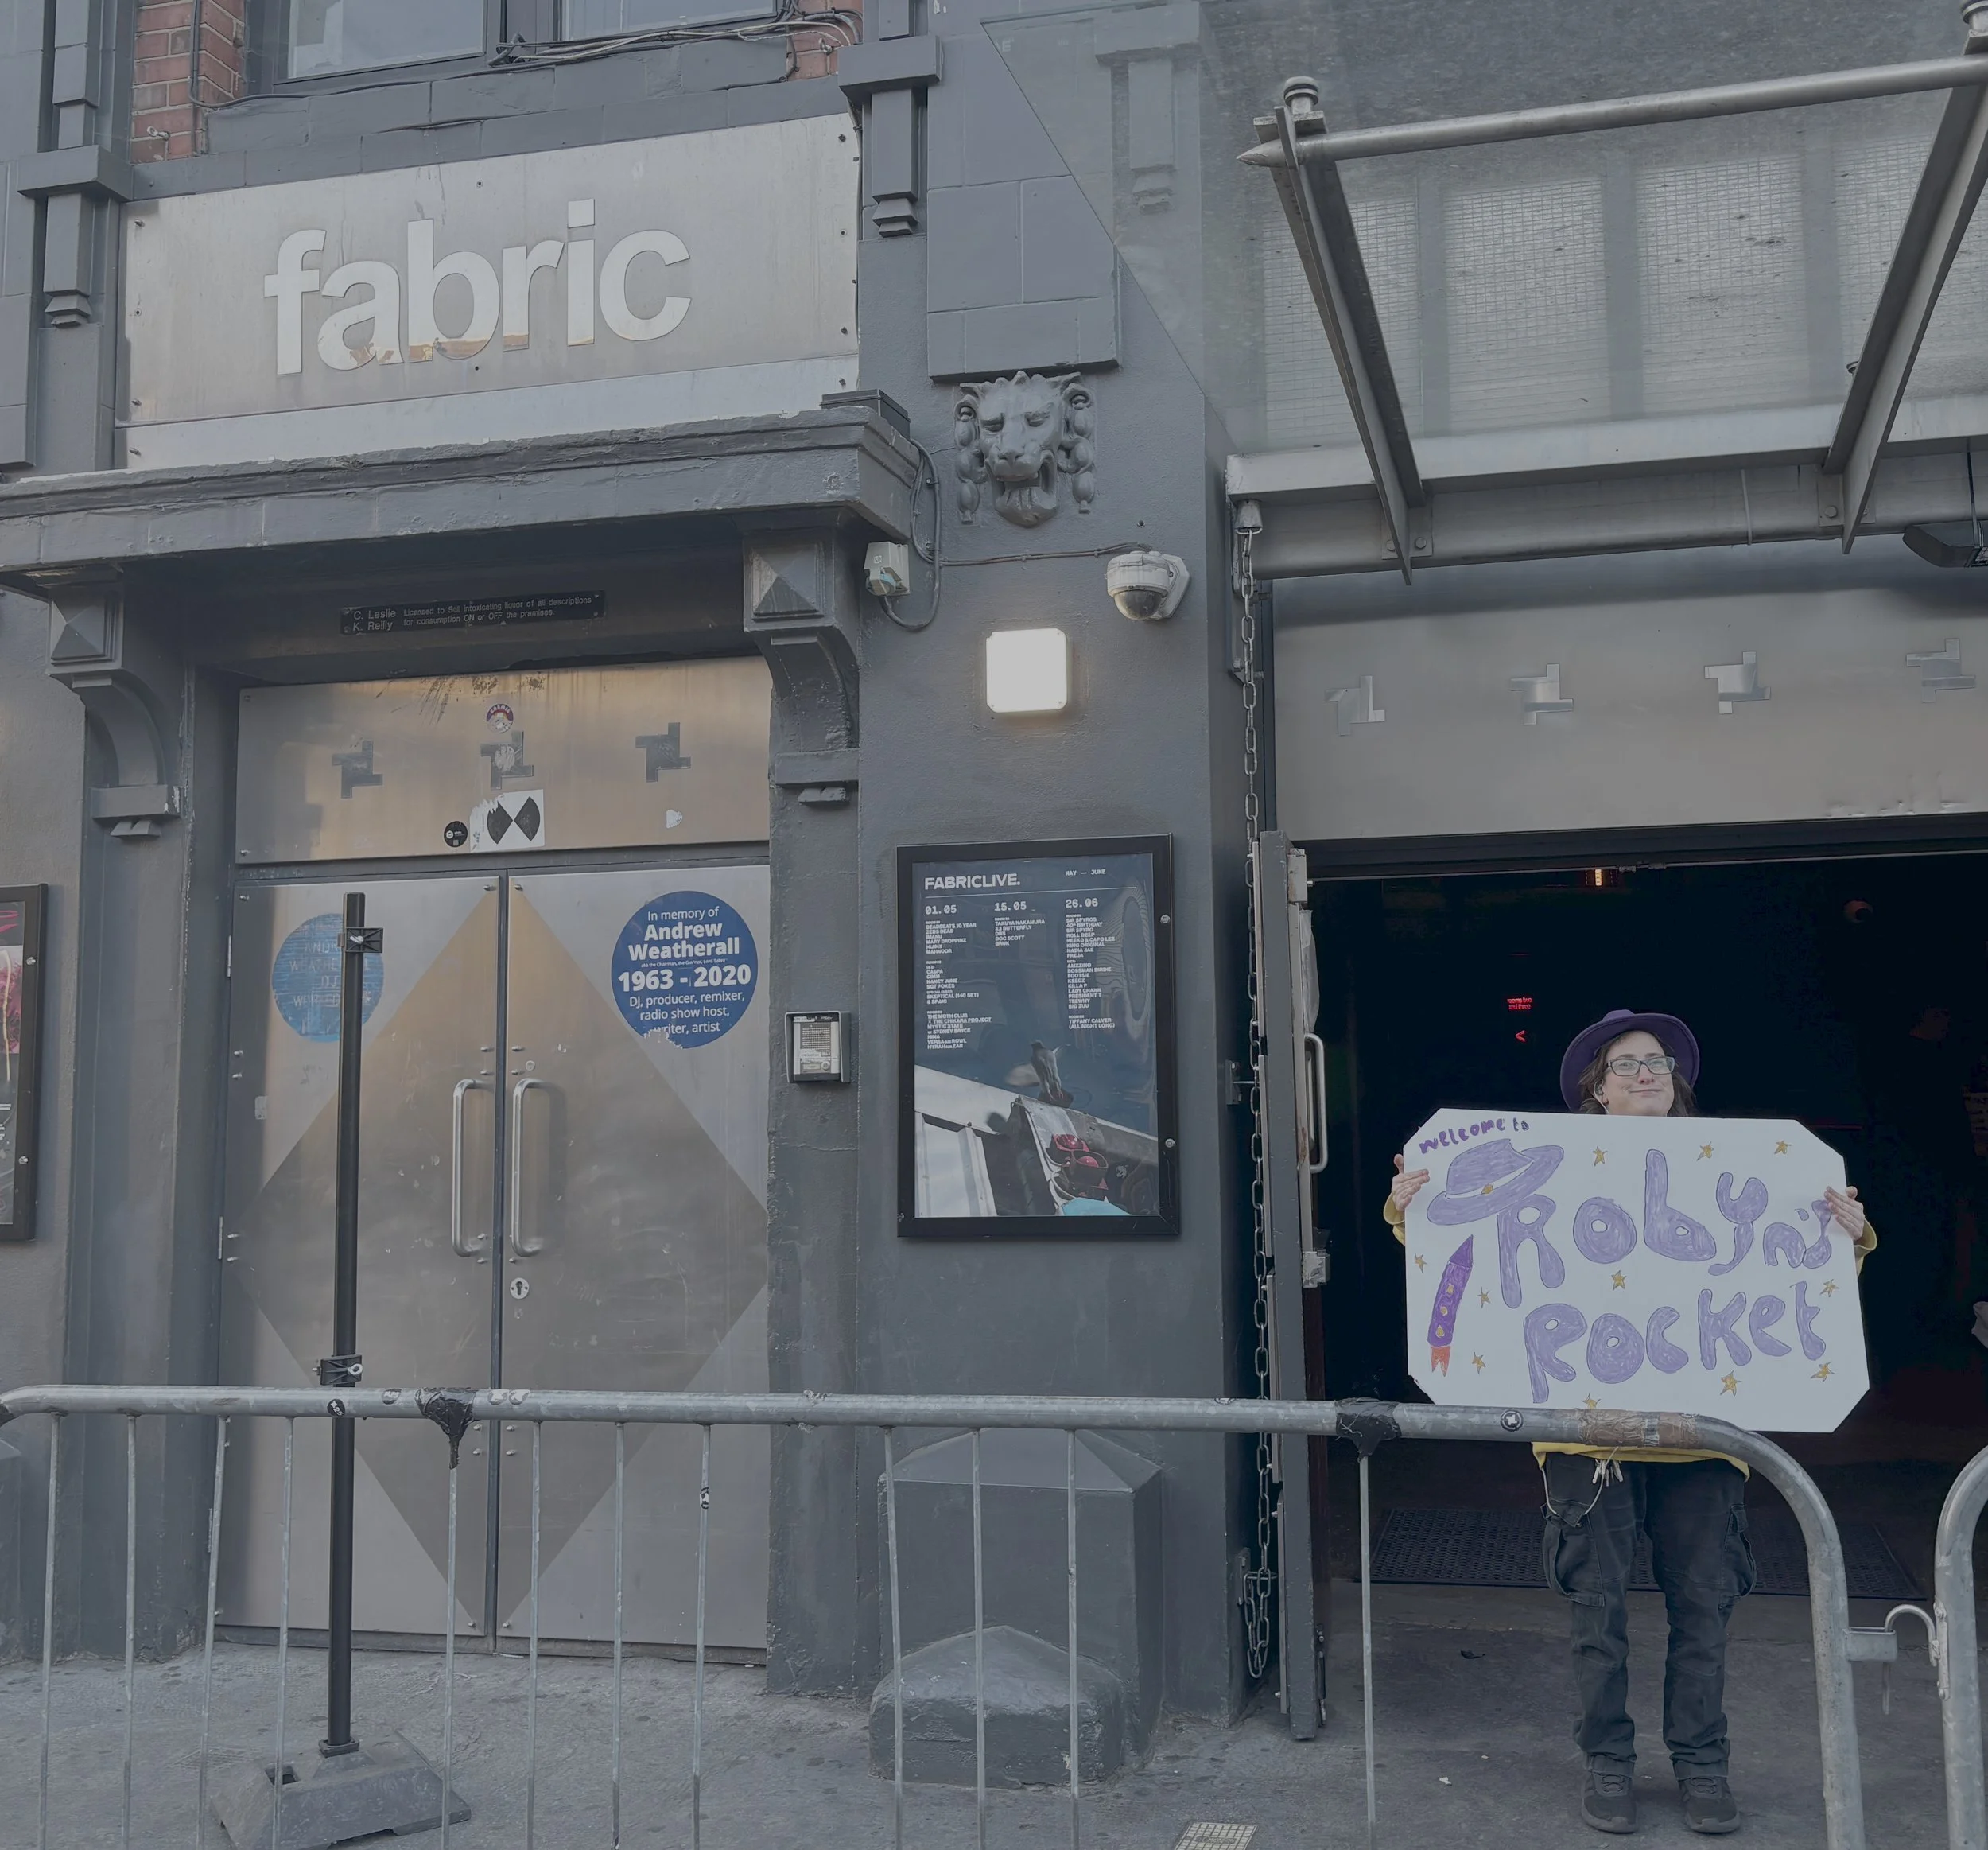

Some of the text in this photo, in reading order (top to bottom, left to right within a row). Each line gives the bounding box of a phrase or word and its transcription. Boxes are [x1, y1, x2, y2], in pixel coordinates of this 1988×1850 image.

[264, 198, 691, 375] fabric
[404, 608, 433, 616] Licensed
[464, 603, 501, 612] intoxicating
[549, 597, 592, 606] descriptions
[354, 609, 395, 620] C. Leslie
[417, 616, 460, 624] consumption
[520, 609, 554, 618] premises.
[353, 620, 392, 631] K. Reilly
[925, 873, 1020, 889] FABRICLIVE.
[925, 904, 957, 915] 01.05
[994, 901, 1027, 911] 15.05
[1066, 898, 1098, 908] 26.06
[648, 906, 719, 921] In memory of
[644, 922, 722, 940] Andrew
[628, 937, 739, 961] Weatherall
[619, 969, 673, 992] 1963
[694, 965, 751, 987] 2020
[630, 992, 744, 1008] DJ, producer, remixer,
[640, 1007, 729, 1020] radio show host,
[692, 1022, 720, 1032] artist
[1513, 1117, 1529, 1132] to
